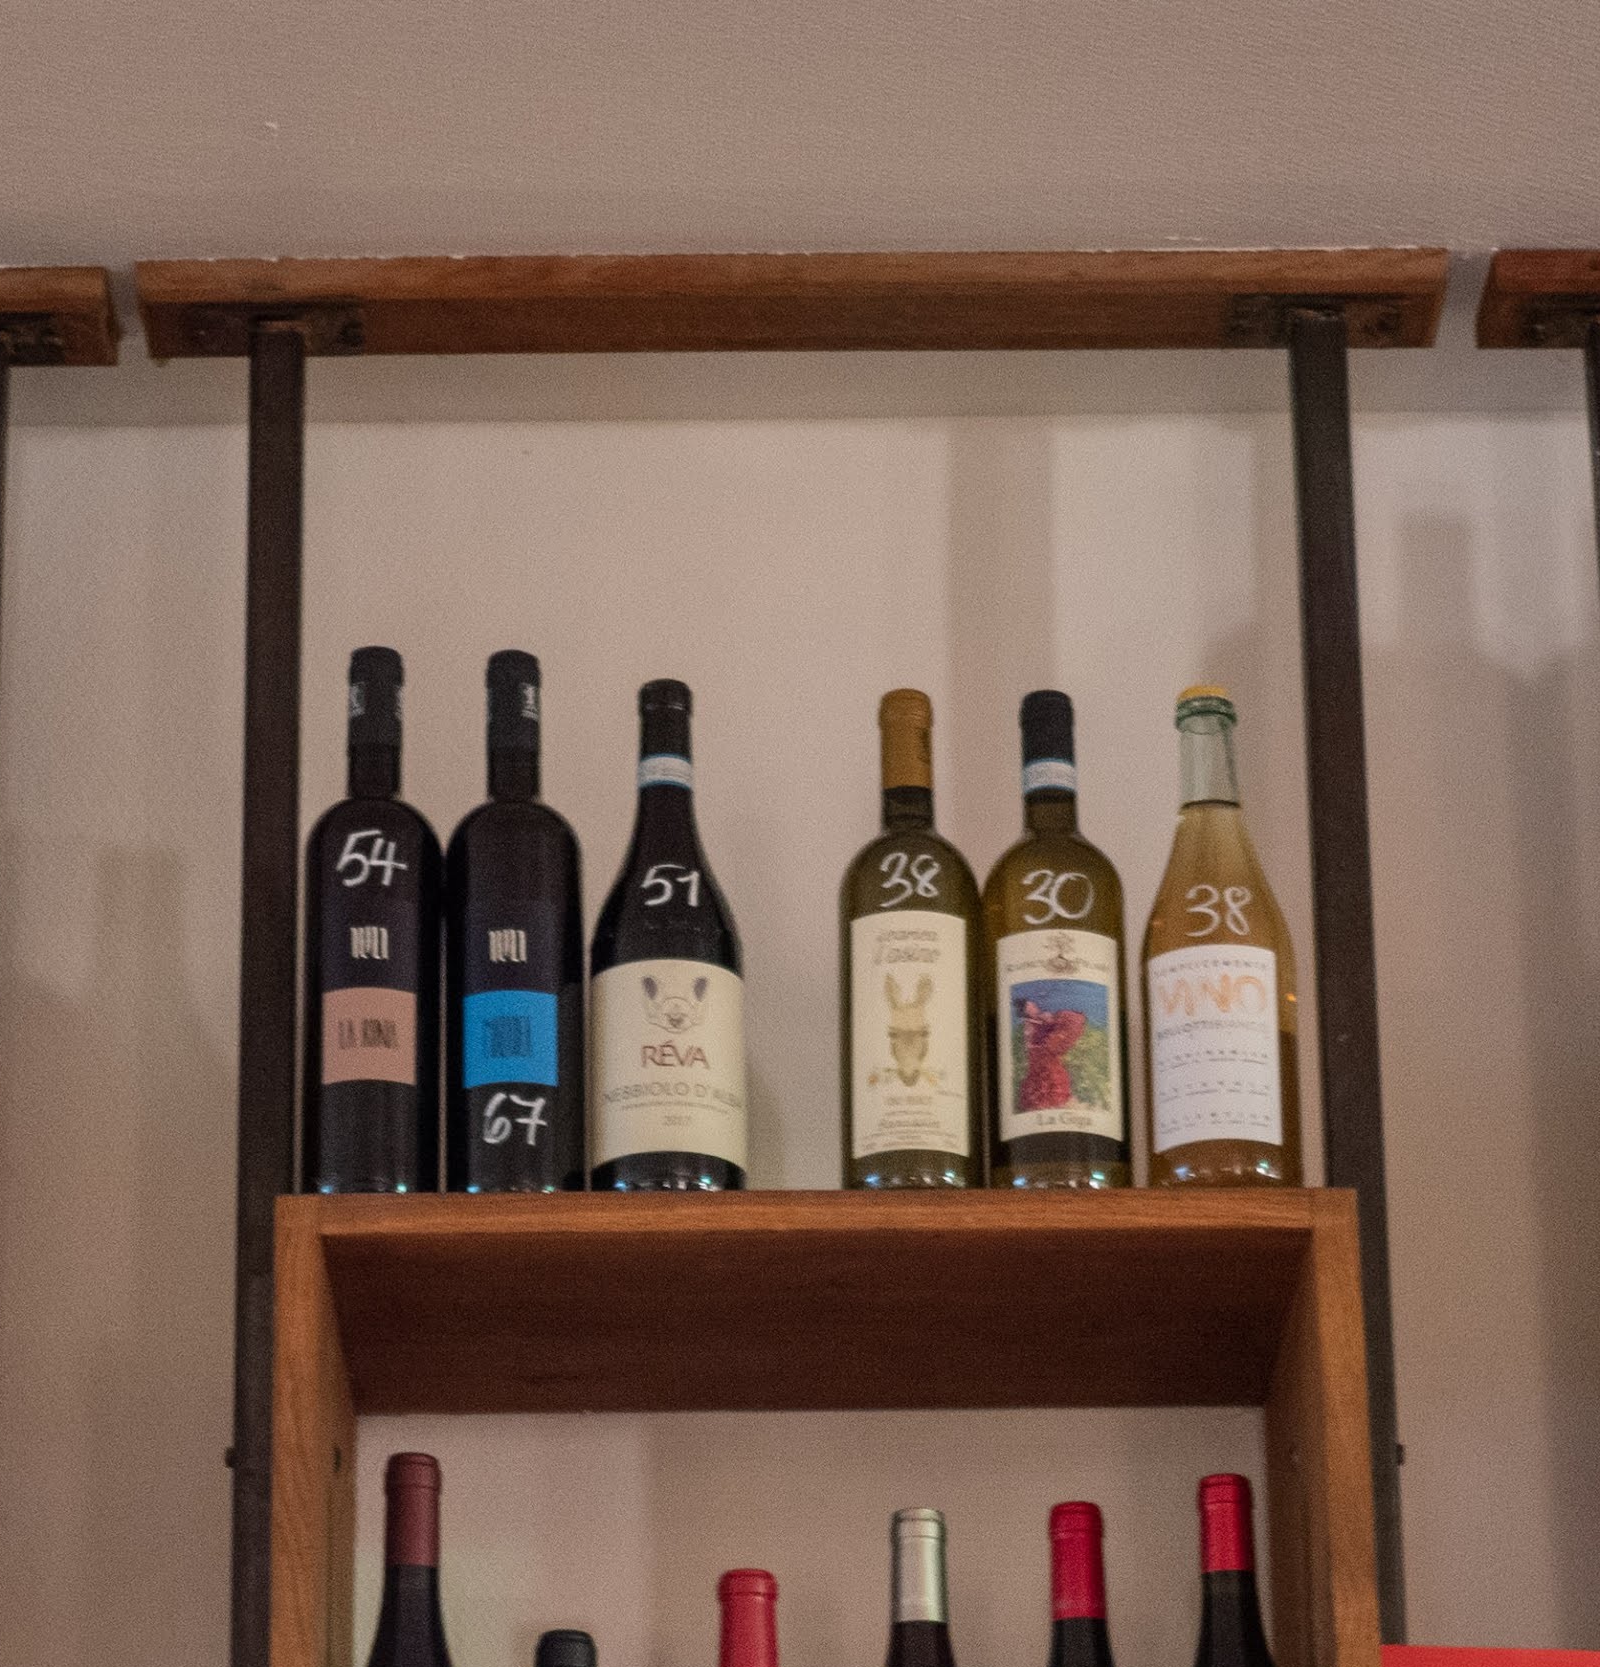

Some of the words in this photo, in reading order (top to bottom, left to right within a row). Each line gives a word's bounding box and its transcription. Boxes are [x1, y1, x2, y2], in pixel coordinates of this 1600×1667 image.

[336, 830, 407, 886] 54
[879, 852, 940, 907] 38
[641, 864, 699, 907] 51
[1024, 869, 1094, 924] 30
[1185, 884, 1251, 937] 38
[640, 1040, 710, 1069] RÉVA
[482, 1092, 548, 1146] 67
